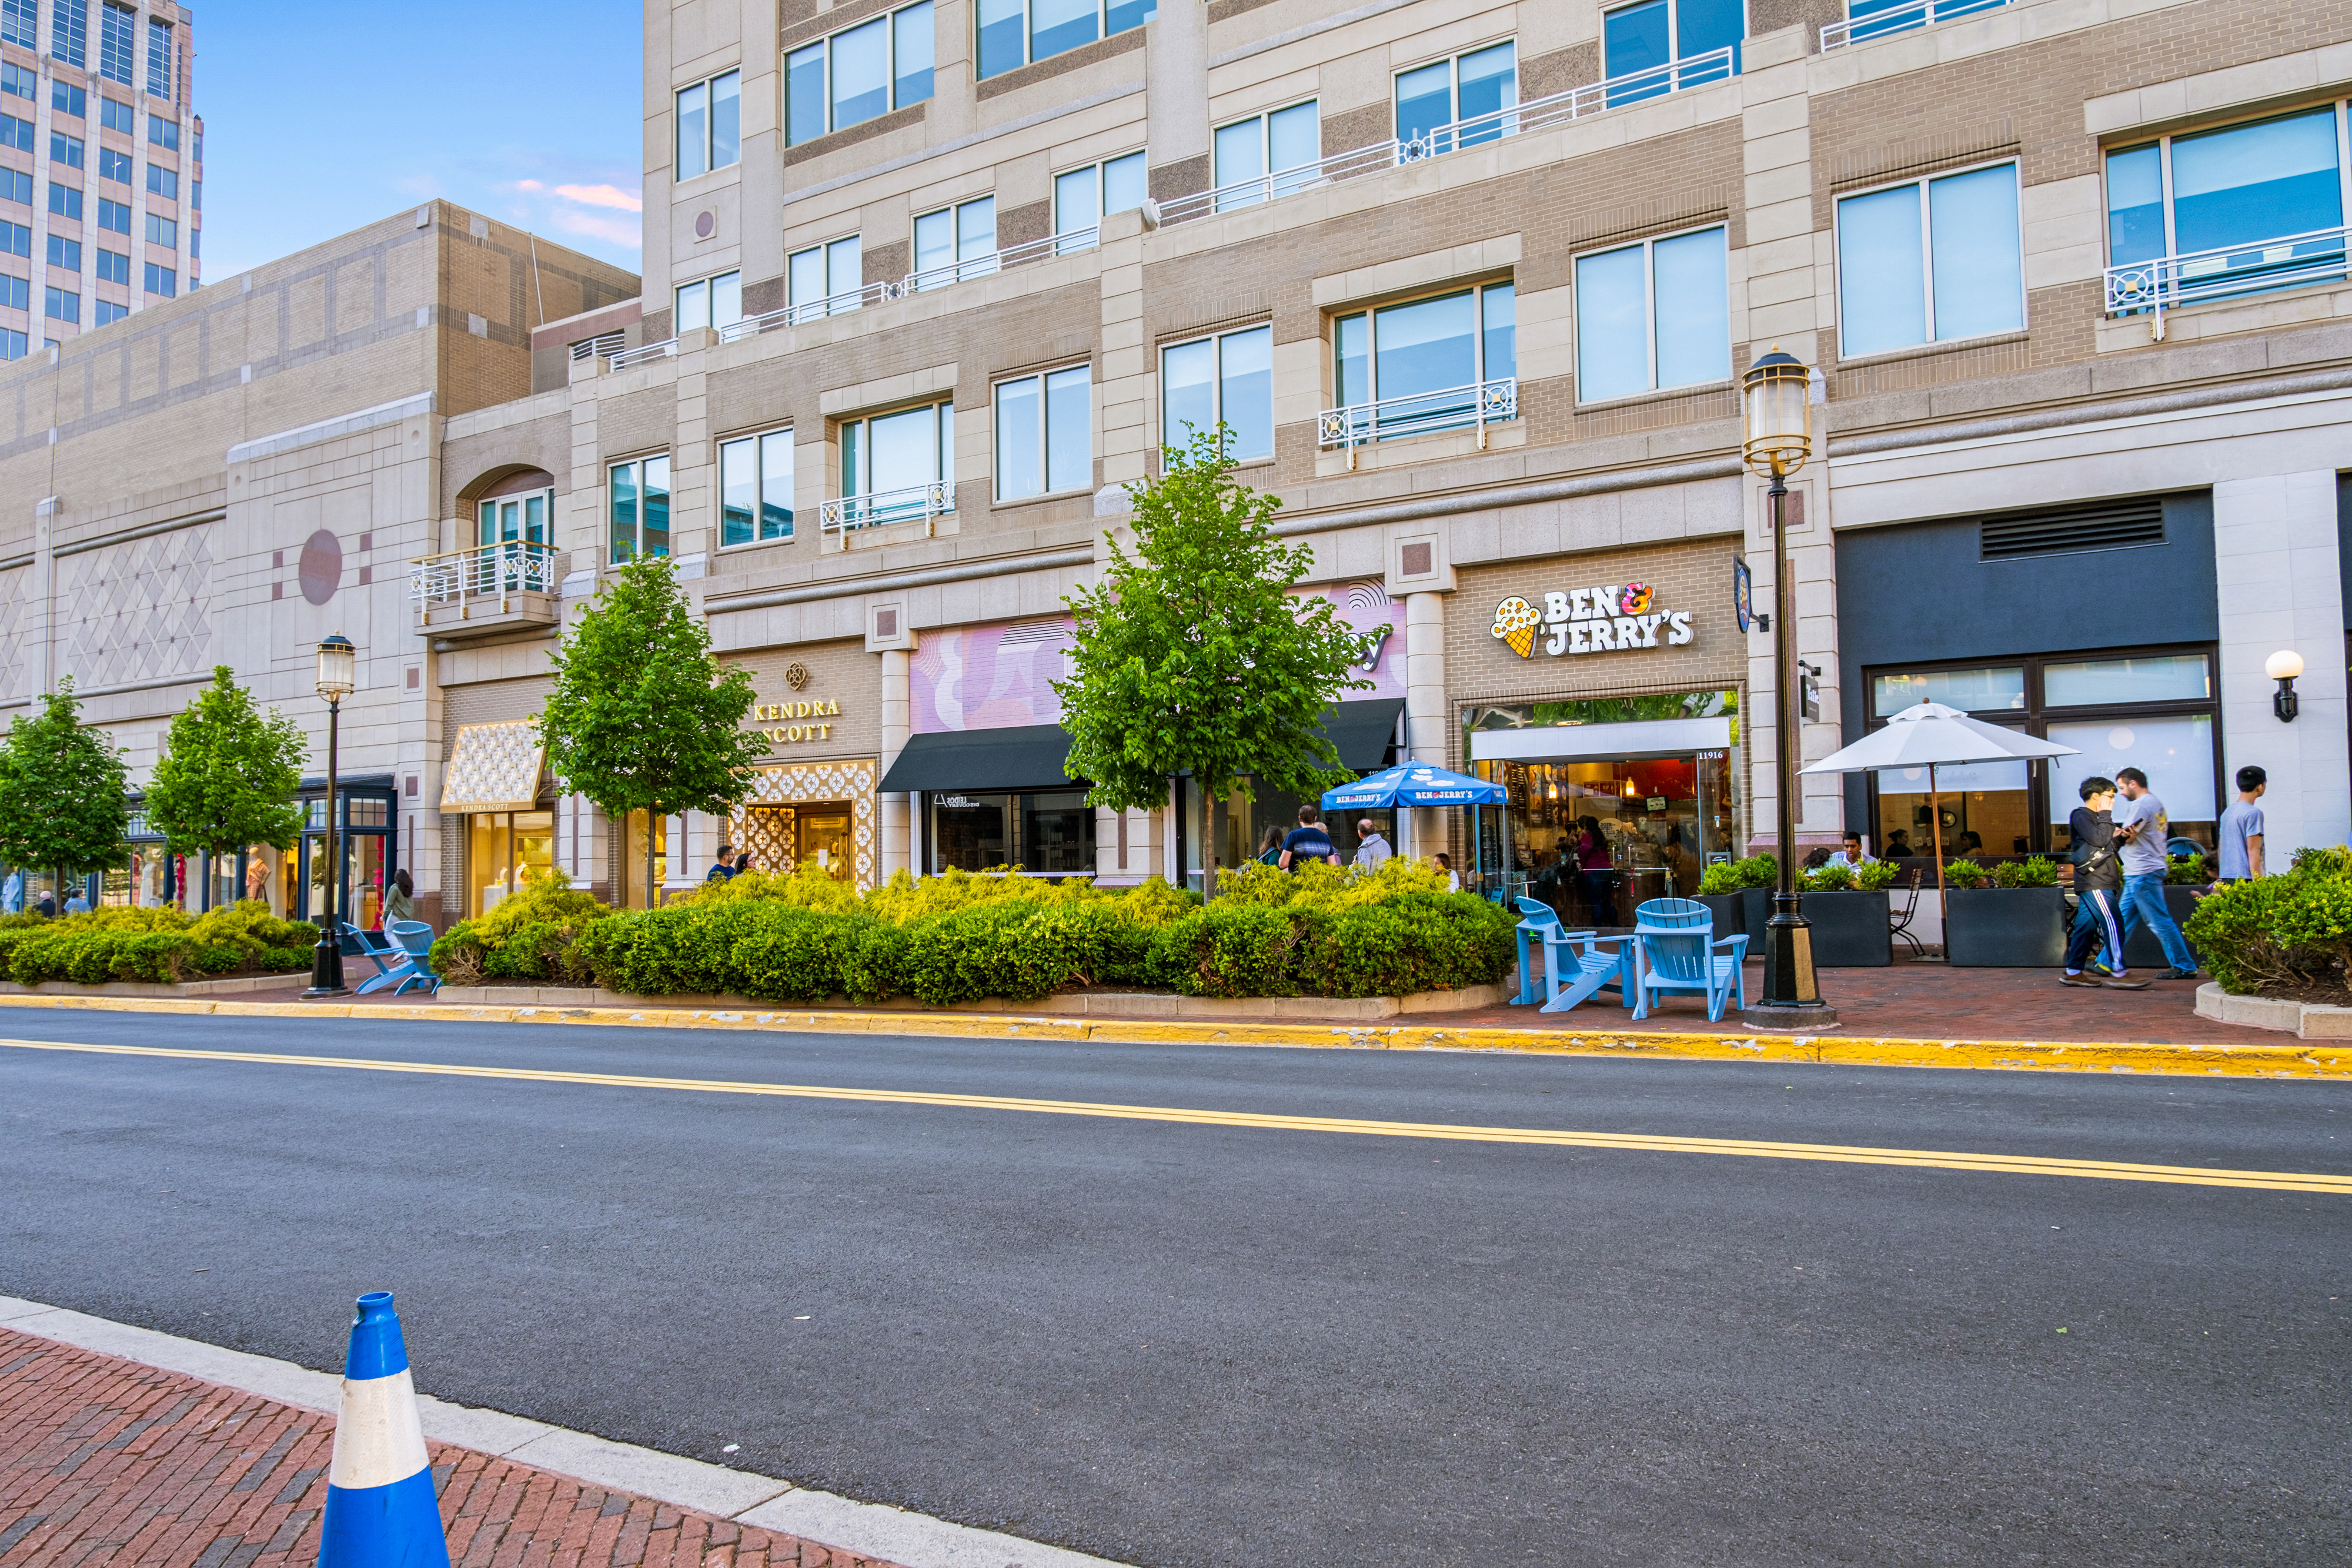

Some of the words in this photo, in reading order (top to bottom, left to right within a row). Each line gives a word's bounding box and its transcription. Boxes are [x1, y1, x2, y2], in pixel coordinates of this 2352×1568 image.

[1544, 585, 1621, 623] BEN
[1622, 582, 1655, 615] &
[1546, 609, 1693, 656] JERRY'S
[754, 698, 840, 721] KENDRA
[763, 723, 831, 743] SCOTT
[1699, 751, 1723, 760] 11916
[1355, 793, 1381, 802] JERRY'S
[1439, 790, 1472, 798] JERRY'S
